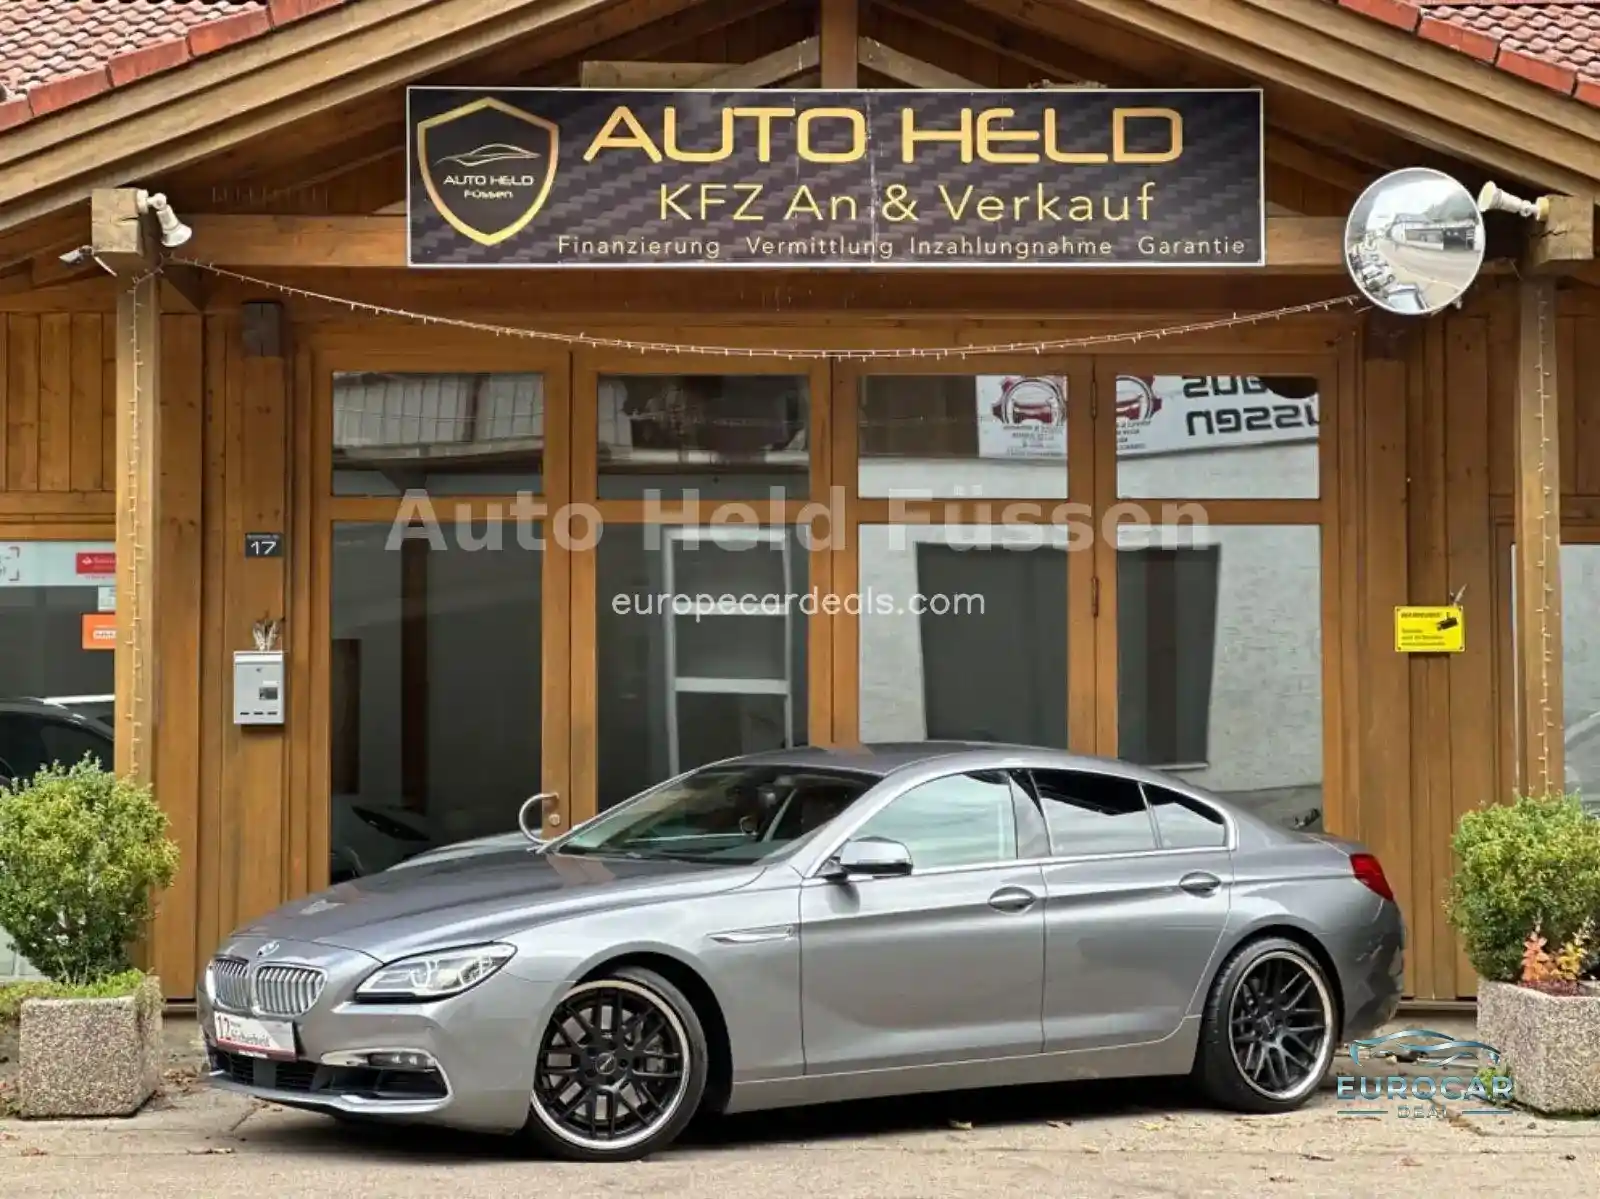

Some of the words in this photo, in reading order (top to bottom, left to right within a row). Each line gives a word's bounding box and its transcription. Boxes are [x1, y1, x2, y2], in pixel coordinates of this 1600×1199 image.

[583, 105, 867, 163] AUTO
[902, 106, 1183, 164] HELD
[443, 175, 487, 186] AUTO
[490, 175, 534, 186] HELD
[660, 183, 764, 221] KFZ
[784, 184, 857, 221] An
[881, 183, 918, 221] &
[938, 182, 1156, 221] Verkauf
[558, 235, 720, 257] Finanzierung
[746, 235, 894, 259] Vermittlung
[909, 235, 1112, 258] Inzahlungnahme
[1137, 235, 1246, 255] Garantie
[250, 540, 277, 556] 17
